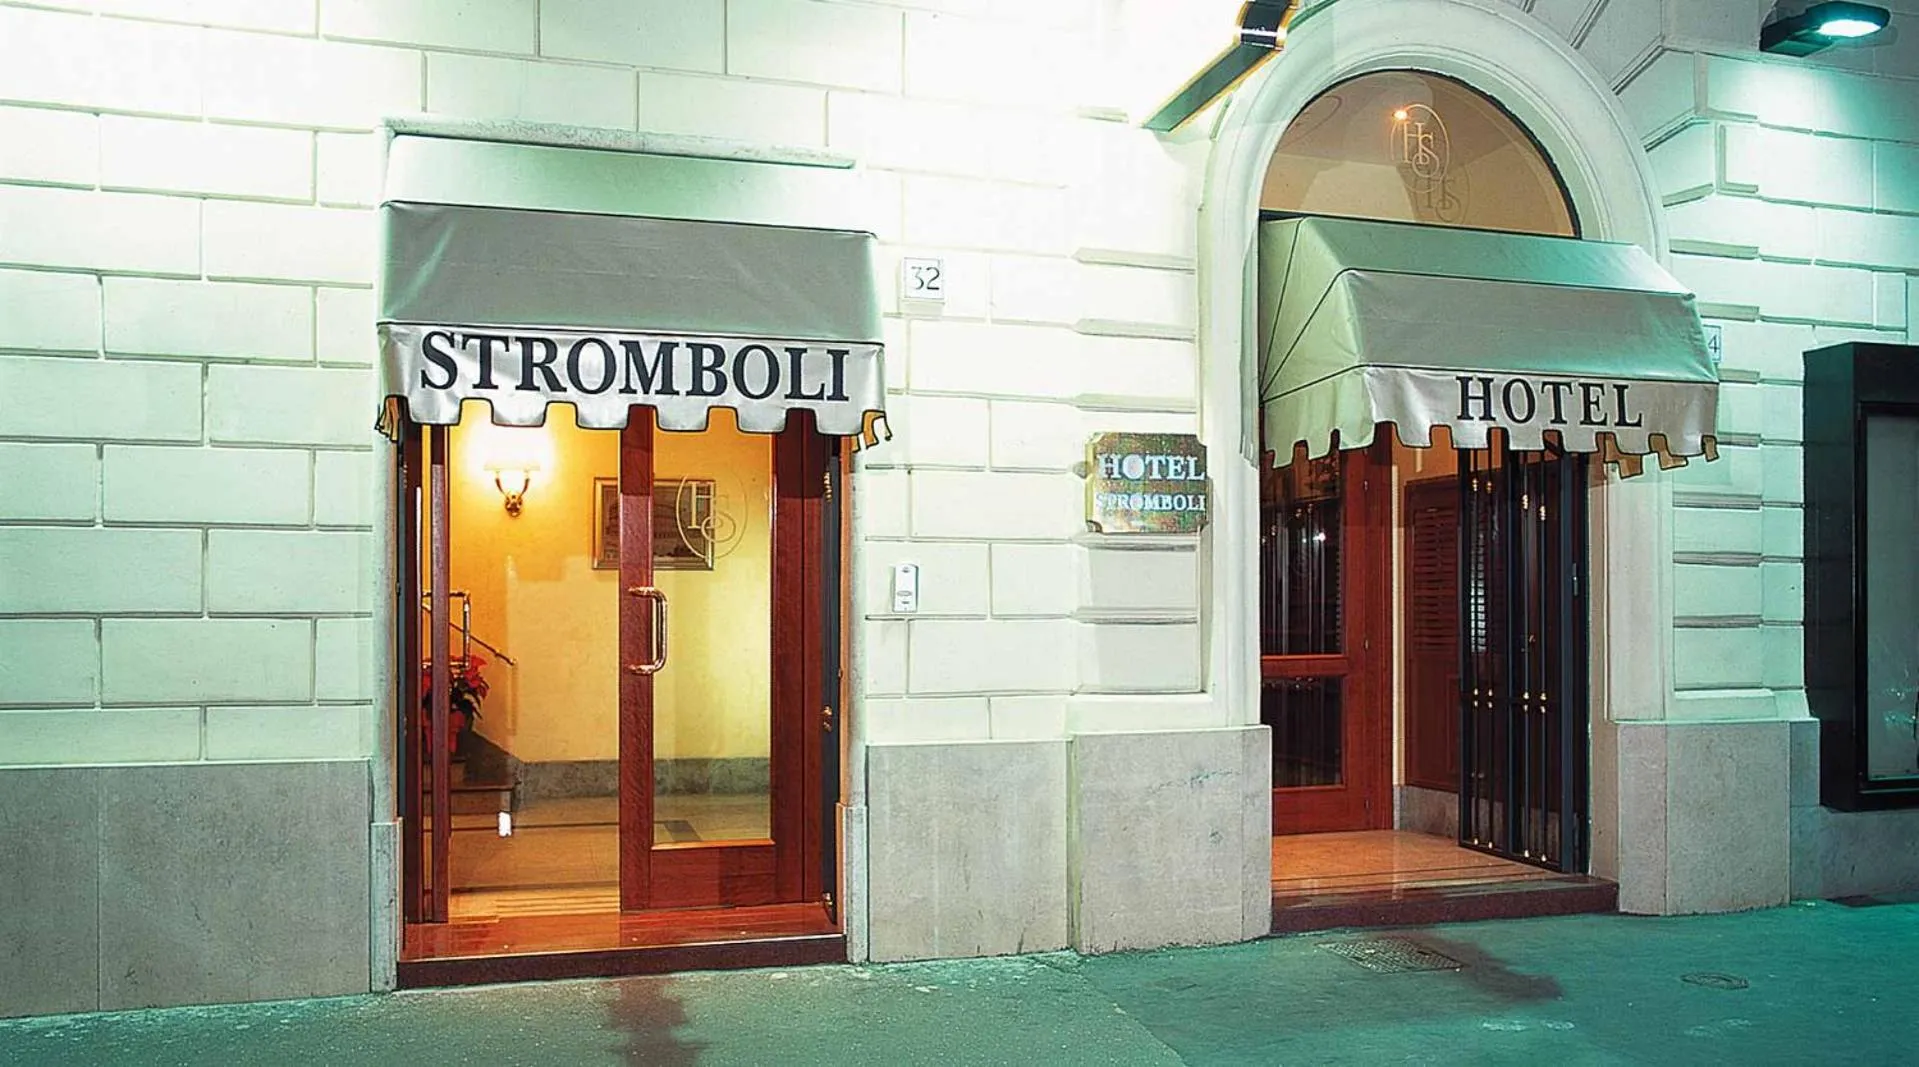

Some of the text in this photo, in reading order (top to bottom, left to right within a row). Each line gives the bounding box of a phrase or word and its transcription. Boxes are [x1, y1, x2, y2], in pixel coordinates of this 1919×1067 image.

[911, 266, 940, 290] 32
[420, 331, 850, 402] STROMBOLI
[1455, 375, 1643, 427] HOTEL
[1096, 453, 1206, 481] HOTEL
[1096, 492, 1206, 512] STROMBOLI
